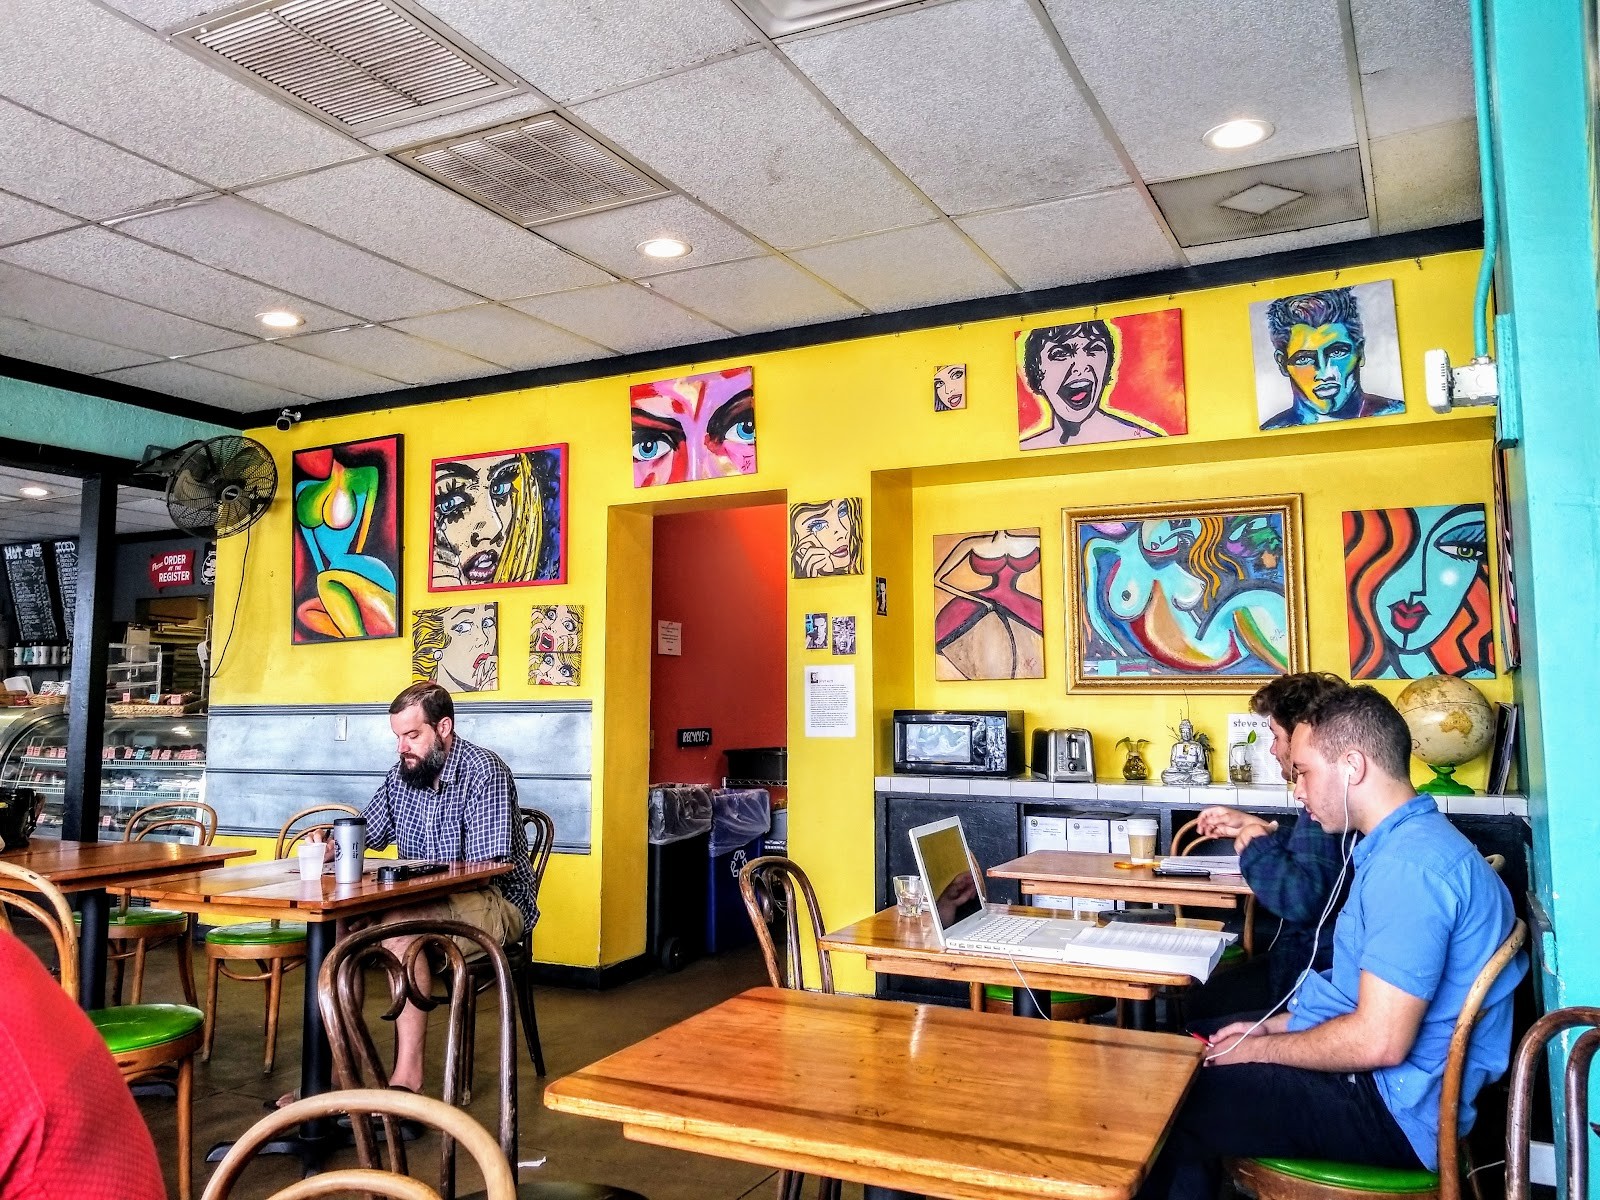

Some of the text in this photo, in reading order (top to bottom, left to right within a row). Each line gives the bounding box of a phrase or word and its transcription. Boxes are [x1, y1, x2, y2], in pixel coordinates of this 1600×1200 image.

[54, 541, 75, 552] ICED
[163, 554, 187, 566] ORDER
[158, 571, 190, 583] REGISTER
[1233, 719, 1257, 727] steve
